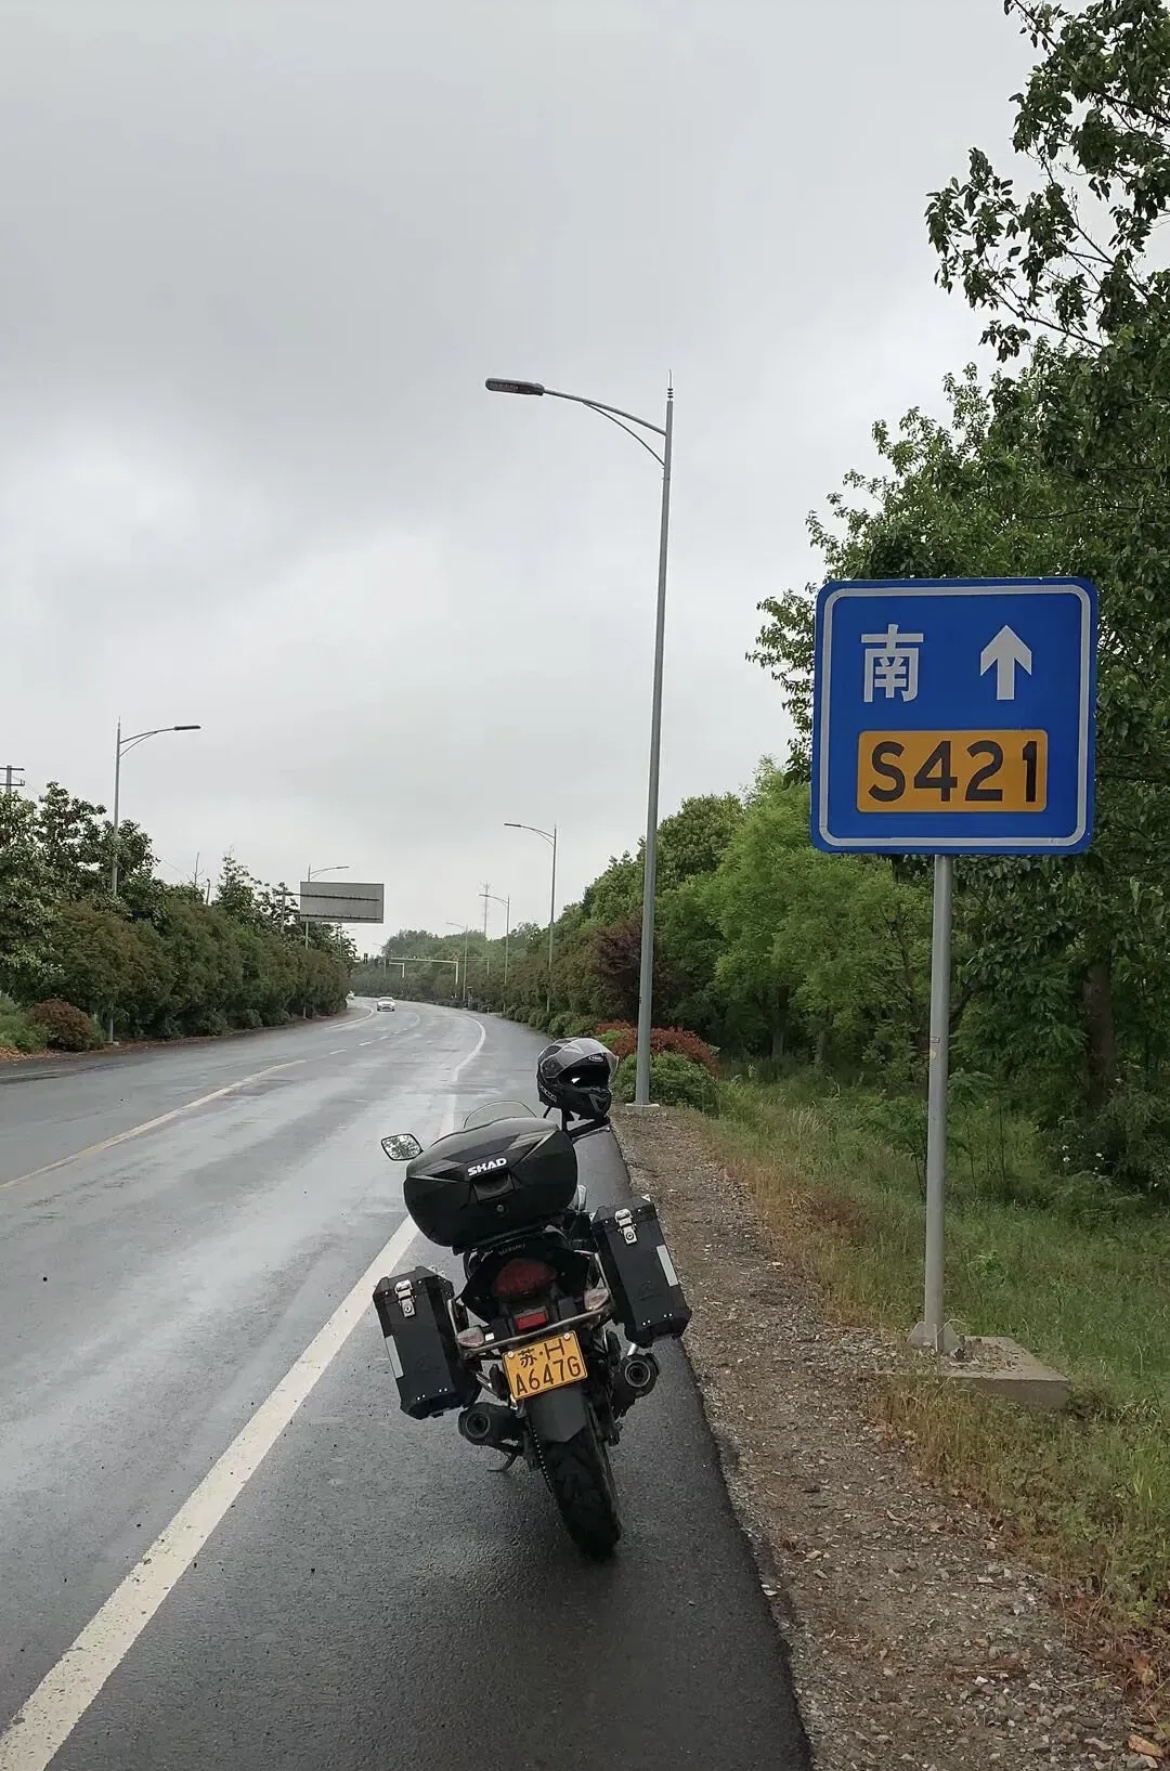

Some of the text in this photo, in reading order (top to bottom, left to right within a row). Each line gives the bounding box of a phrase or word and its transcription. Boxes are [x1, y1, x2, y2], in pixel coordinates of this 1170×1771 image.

[861, 624, 924, 702] 南
[868, 740, 1038, 802] S421
[467, 1157, 507, 1176] SHAD
[515, 1356, 581, 1396] A647G
